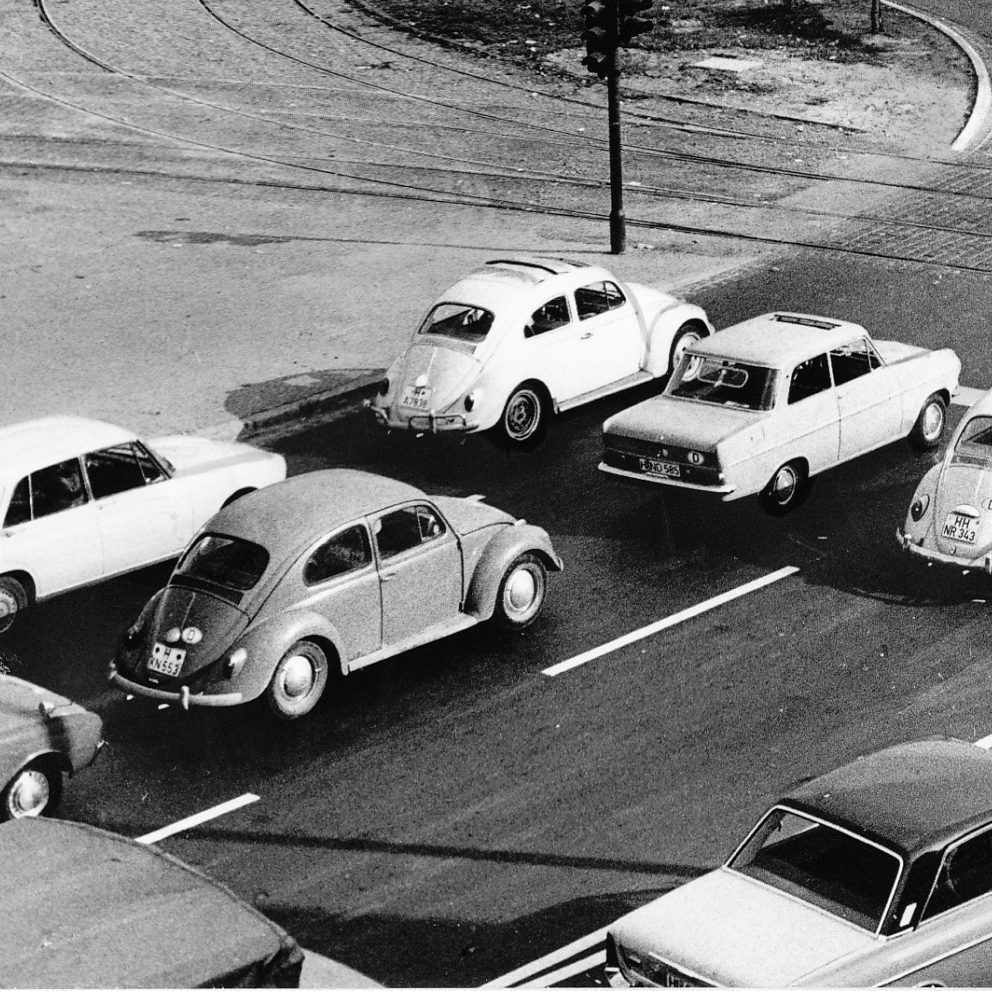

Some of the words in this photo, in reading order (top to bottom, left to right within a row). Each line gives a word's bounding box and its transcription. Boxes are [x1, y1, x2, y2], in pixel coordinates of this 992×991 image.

[692, 452, 700, 463] D
[954, 516, 971, 529] HH
[943, 524, 957, 537] NR
[958, 528, 976, 541] 343
[187, 629, 196, 641] D
